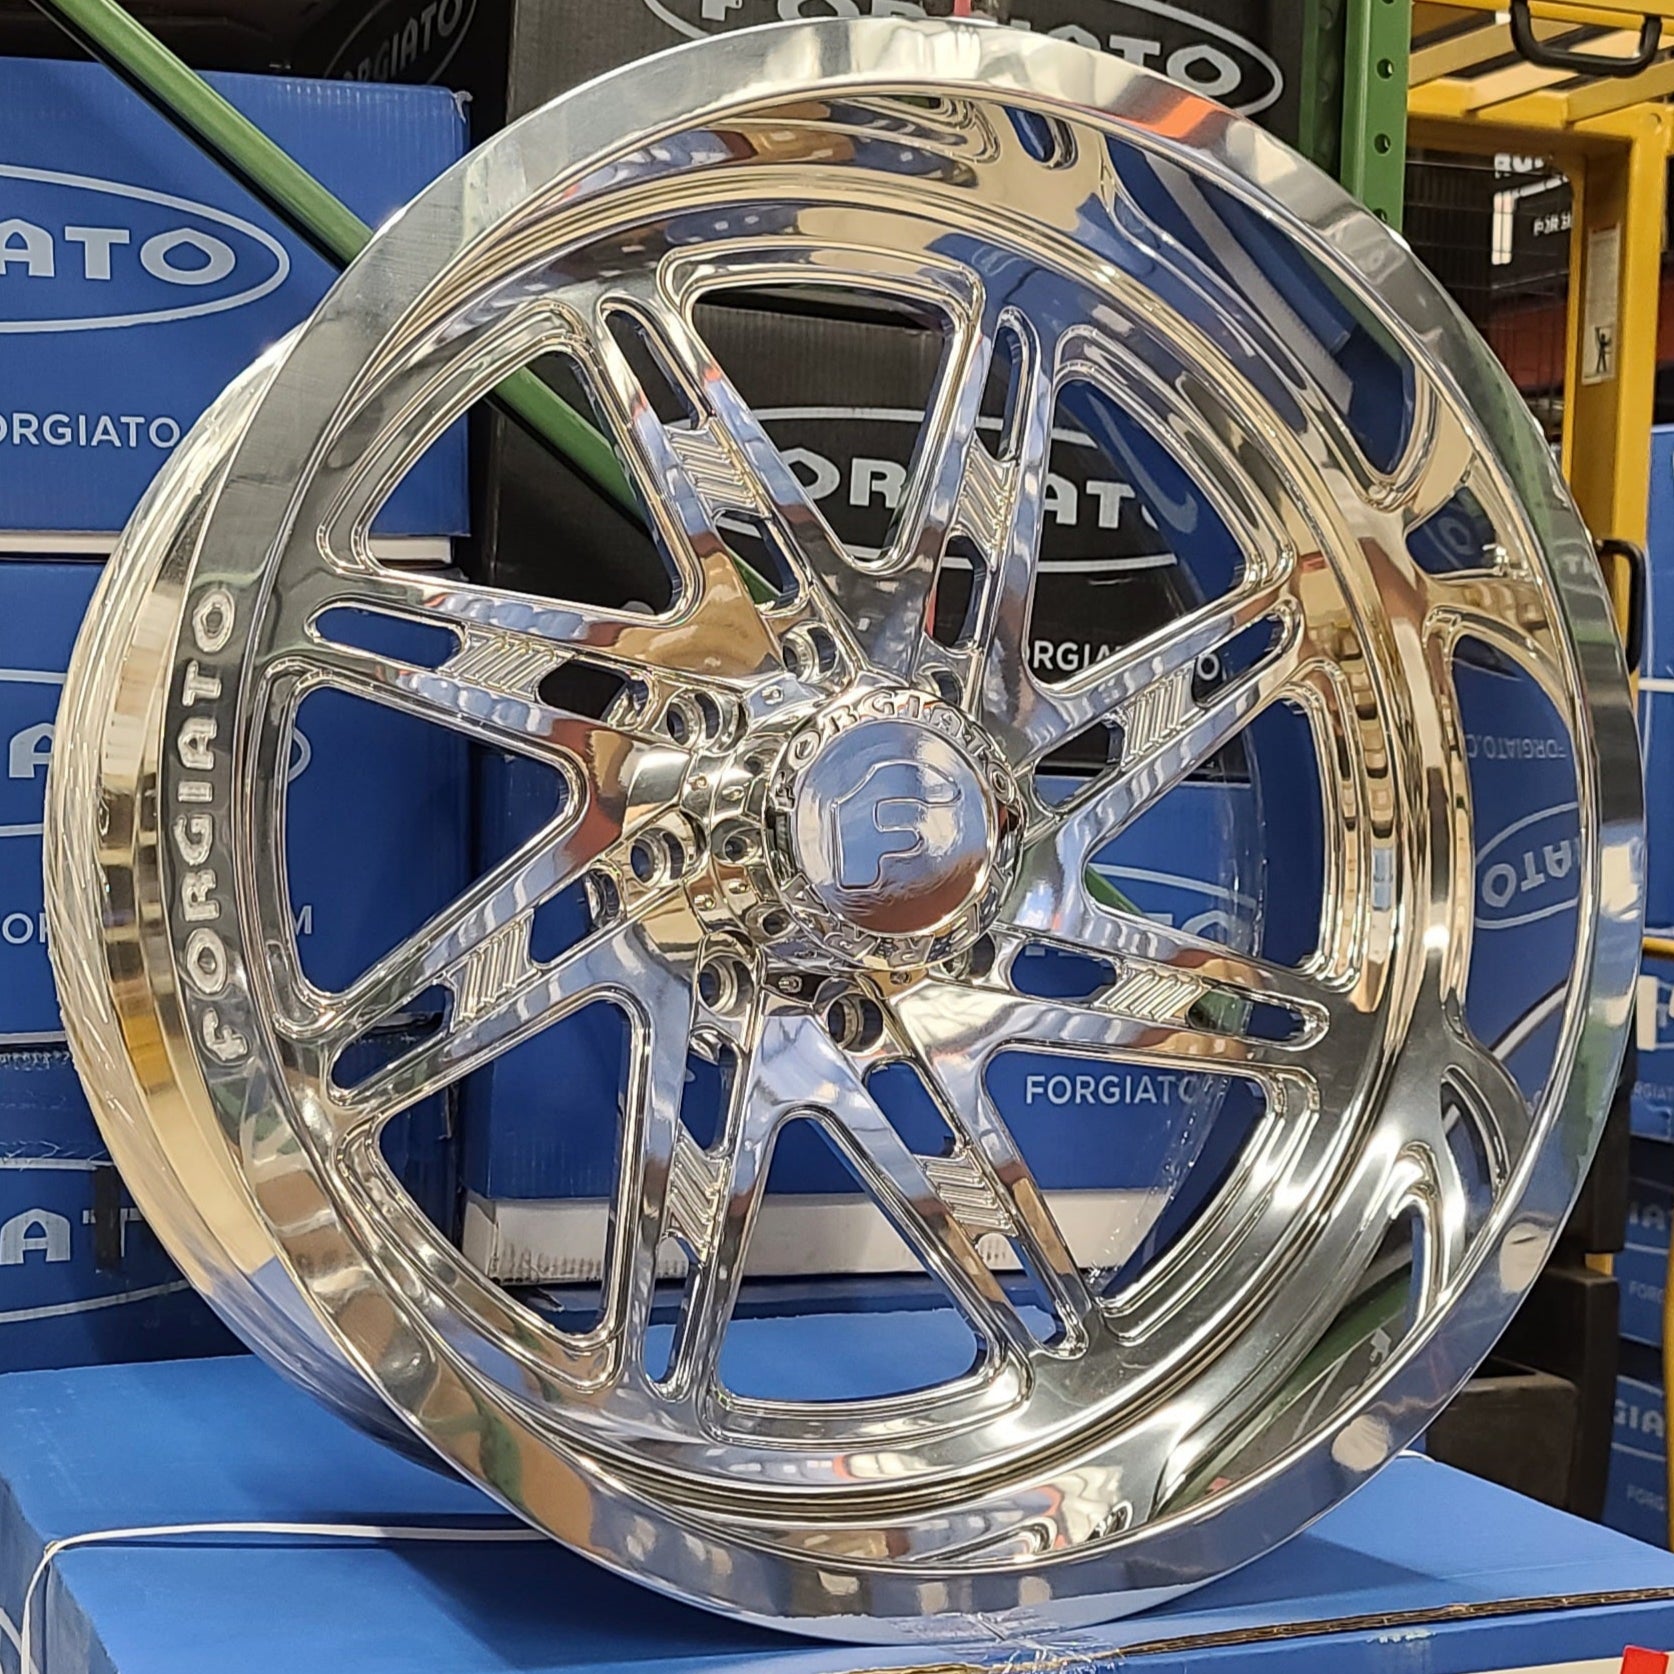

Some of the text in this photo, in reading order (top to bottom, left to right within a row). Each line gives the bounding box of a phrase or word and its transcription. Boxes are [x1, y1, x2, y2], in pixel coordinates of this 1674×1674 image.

[342, 0, 463, 82] RGIATO
[0, 412, 181, 448] RGIATO
[769, 687, 1016, 812] FORGIATO
[173, 588, 248, 1062] FORGIATO
